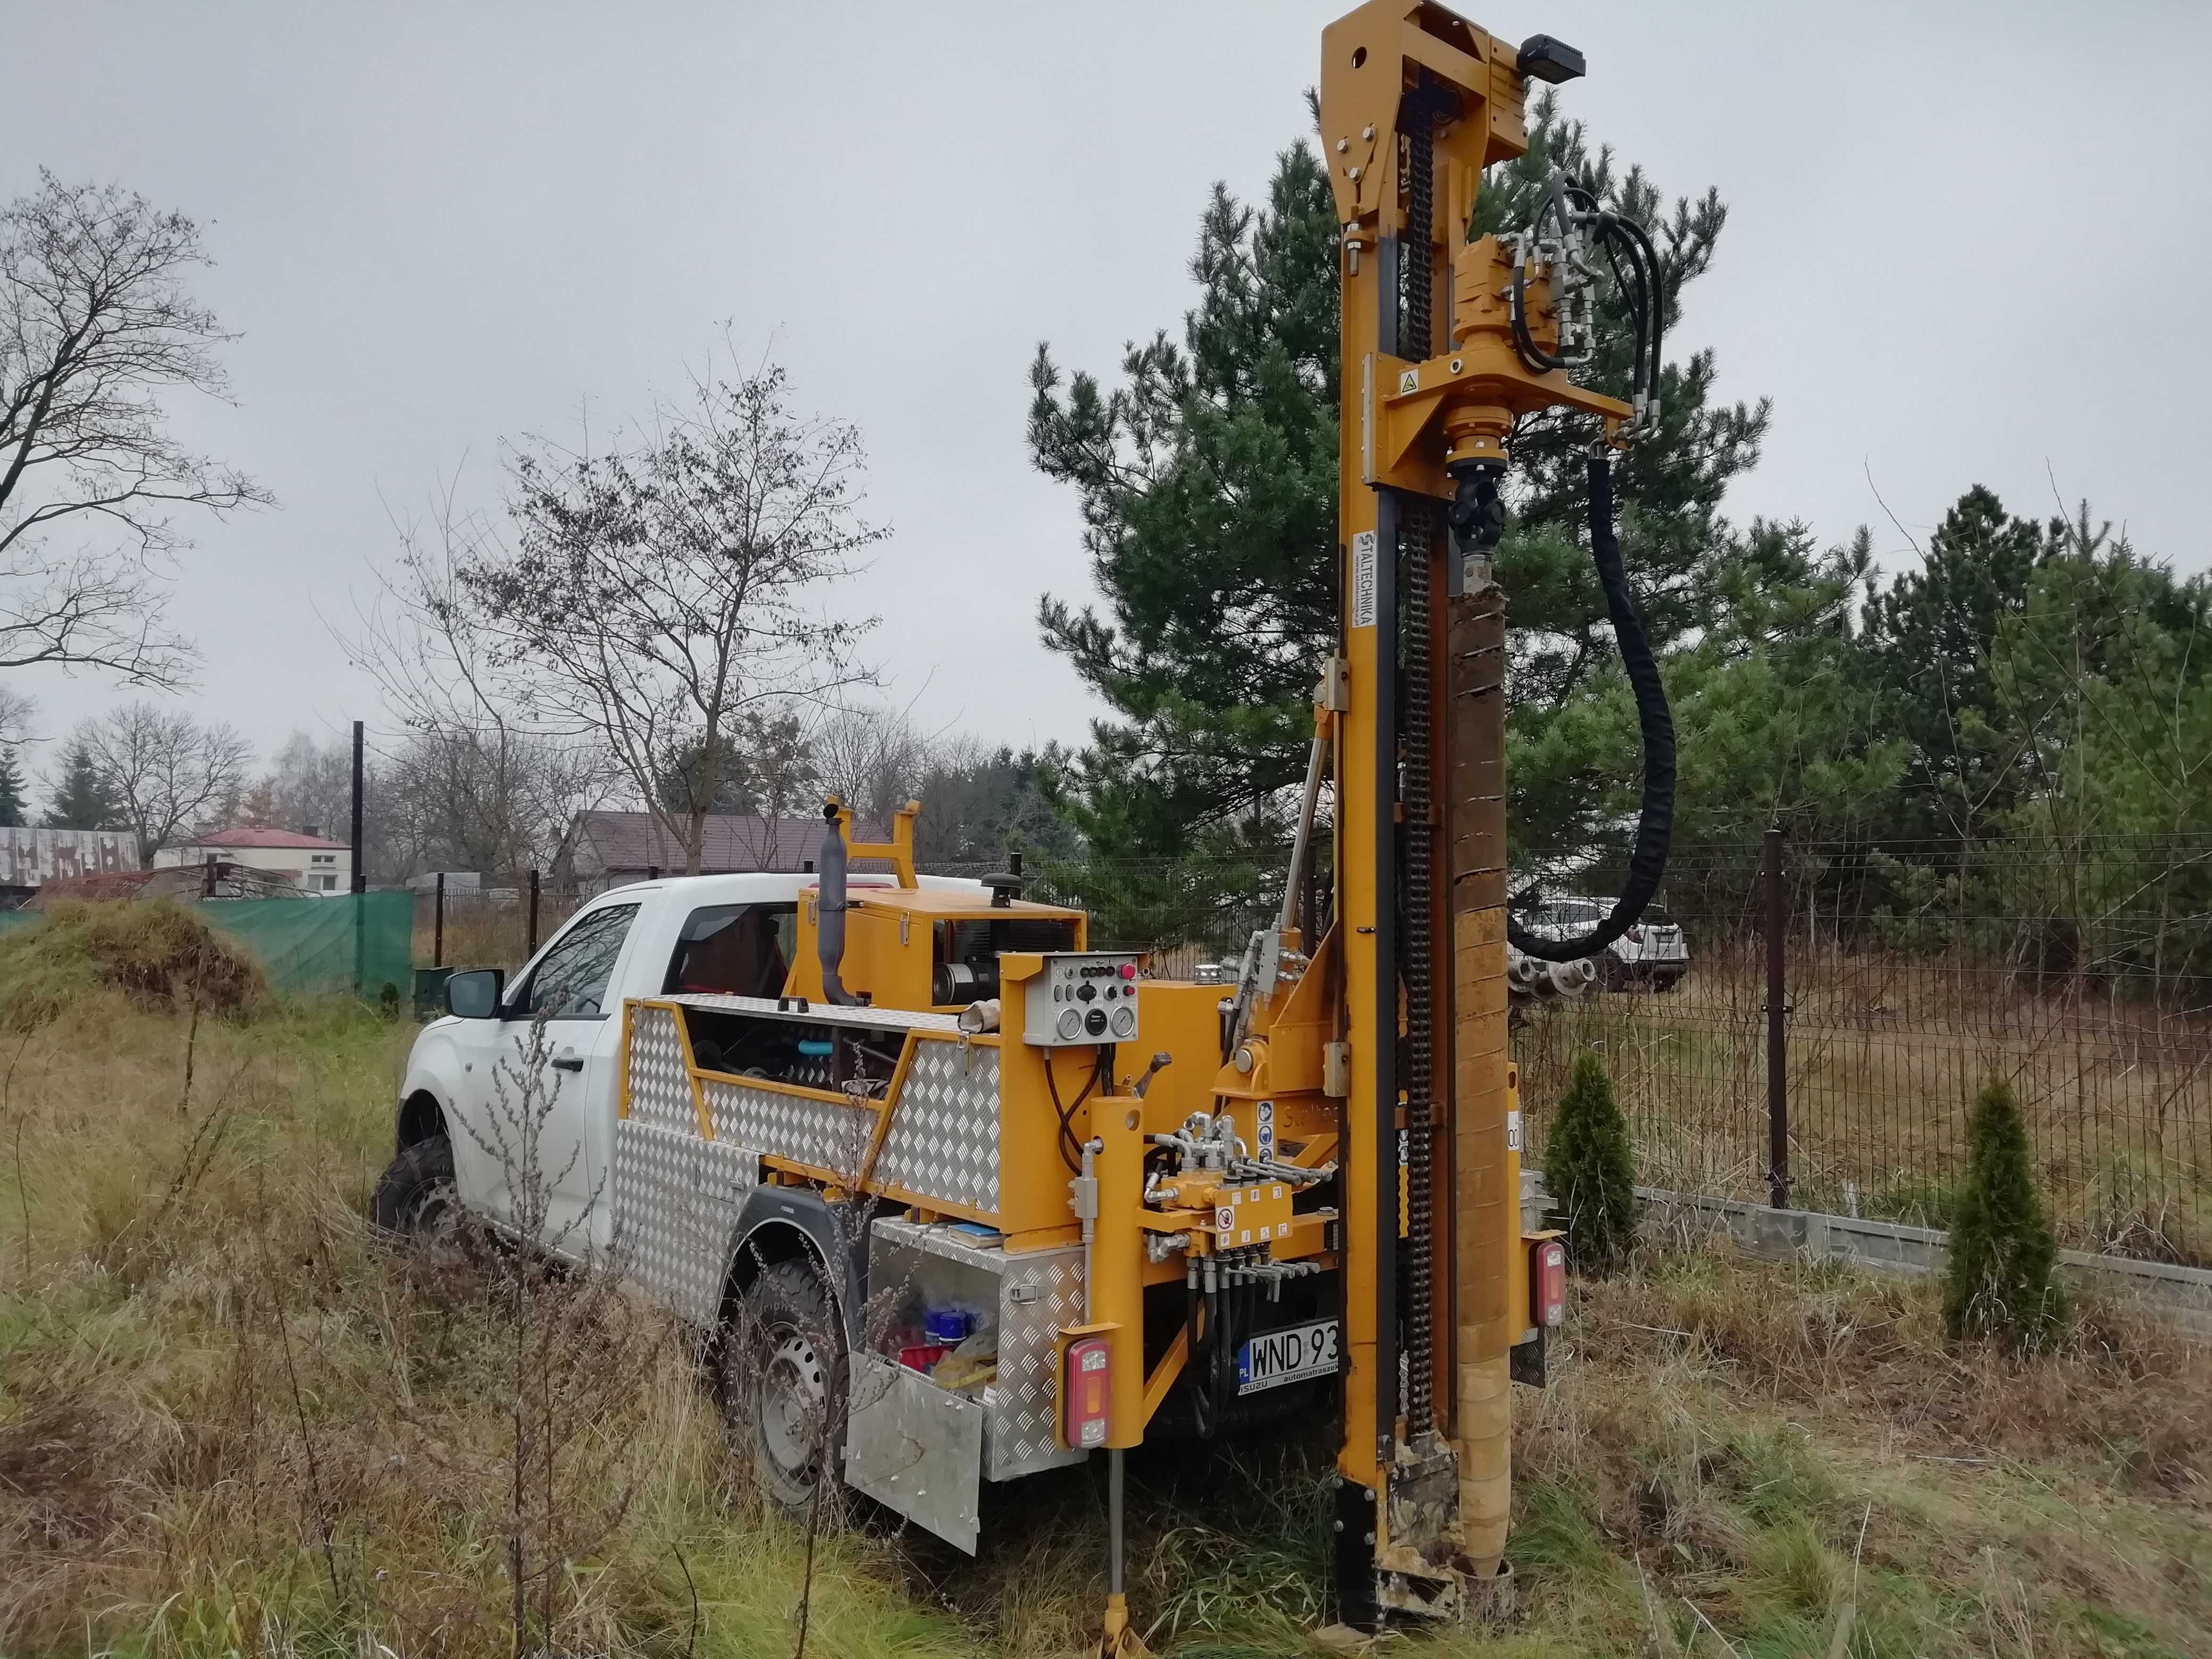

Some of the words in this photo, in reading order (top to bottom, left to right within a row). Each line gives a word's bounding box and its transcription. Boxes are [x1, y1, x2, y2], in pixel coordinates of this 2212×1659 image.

[1359, 533, 1374, 625] STALTECHNIKA
[1253, 1333, 1301, 1378] WND
[1239, 1367, 1249, 1378] PL
[1241, 1380, 1268, 1393] ISUZU
